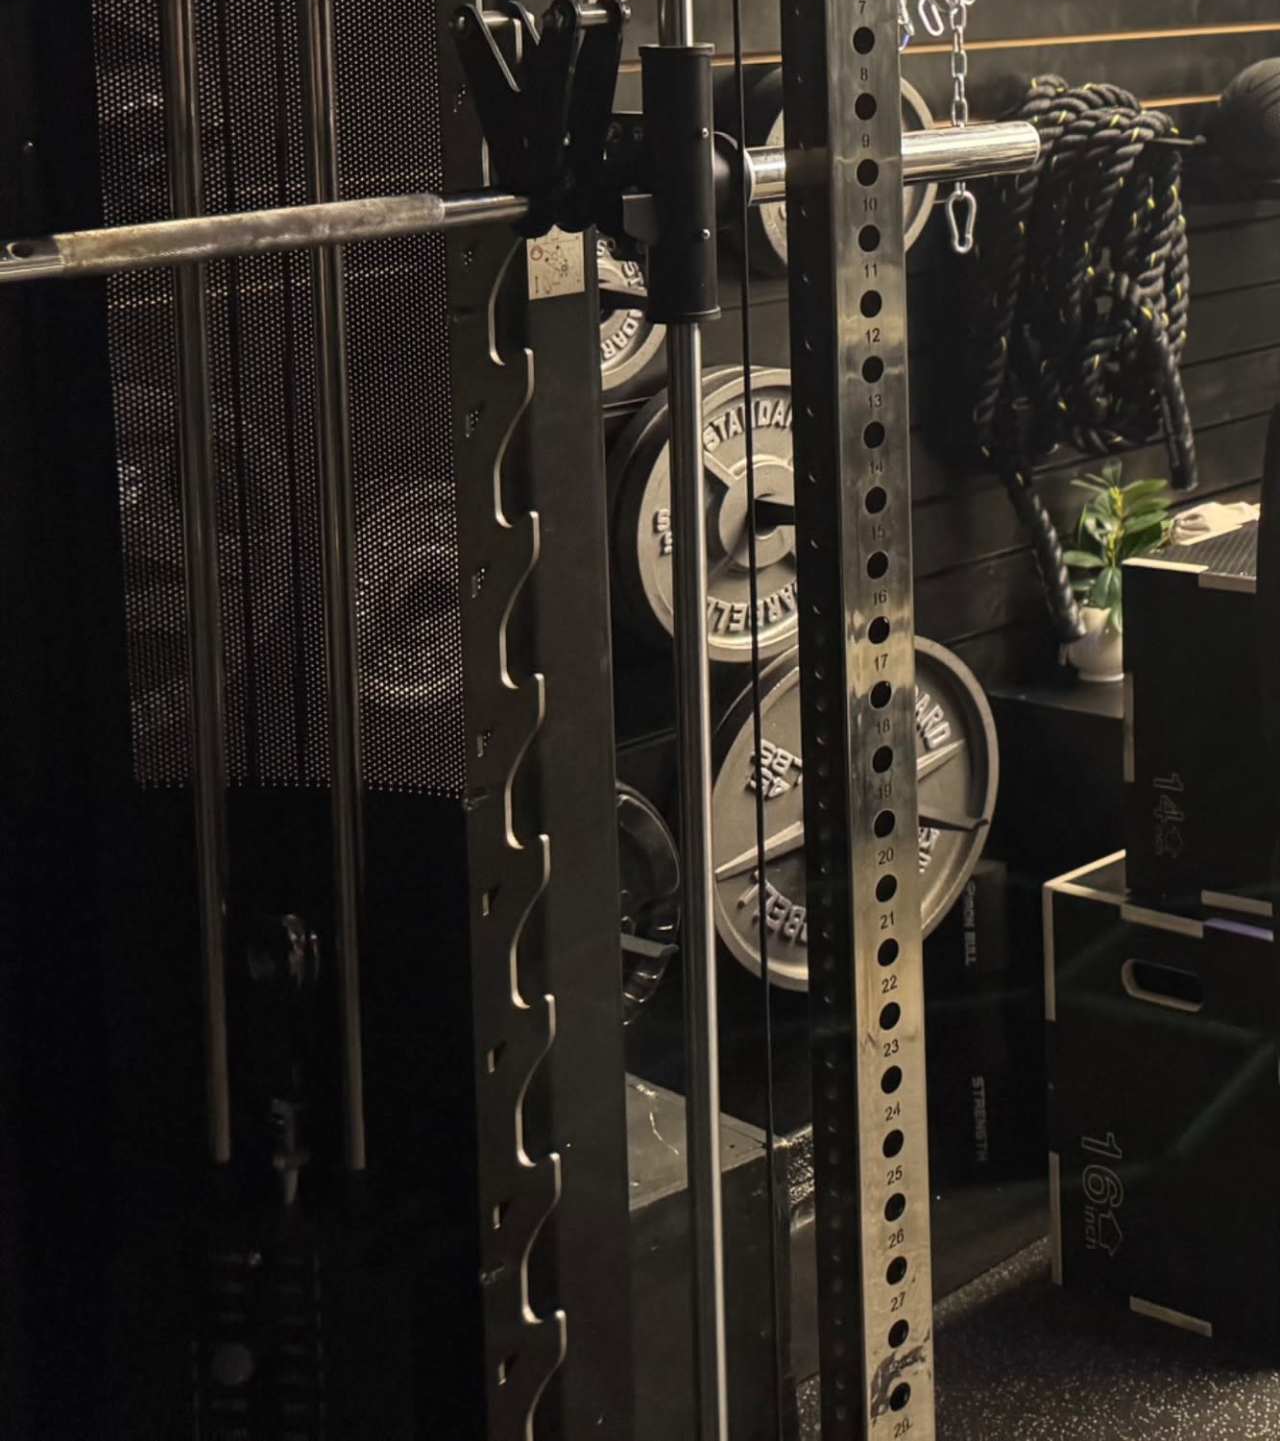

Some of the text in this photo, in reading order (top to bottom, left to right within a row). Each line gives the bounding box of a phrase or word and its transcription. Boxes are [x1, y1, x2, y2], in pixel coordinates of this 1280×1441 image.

[858, 0, 867, 14] 7
[860, 68, 868, 81] 8
[862, 134, 870, 148] 9
[863, 197, 877, 211] 10
[864, 264, 878, 278] 11
[865, 328, 881, 343] 12
[867, 394, 882, 408] 13
[869, 462, 883, 474] 14
[871, 526, 885, 540] 15
[873, 590, 887, 605] 16
[706, 580, 798, 634] ARBELL
[874, 653, 888, 672] 17
[876, 719, 890, 734] 18
[878, 784, 892, 799] 19
[1151, 771, 1184, 824] 14
[878, 848, 894, 865] 20
[880, 912, 895, 930] 21
[881, 975, 898, 994] 22
[883, 1039, 899, 1057] 23
[885, 1101, 901, 1121] 24
[886, 1165, 903, 1185] 25
[1081, 1131, 1123, 1249] 16 inch
[888, 1229, 905, 1249] 26
[890, 1291, 906, 1312] 27
